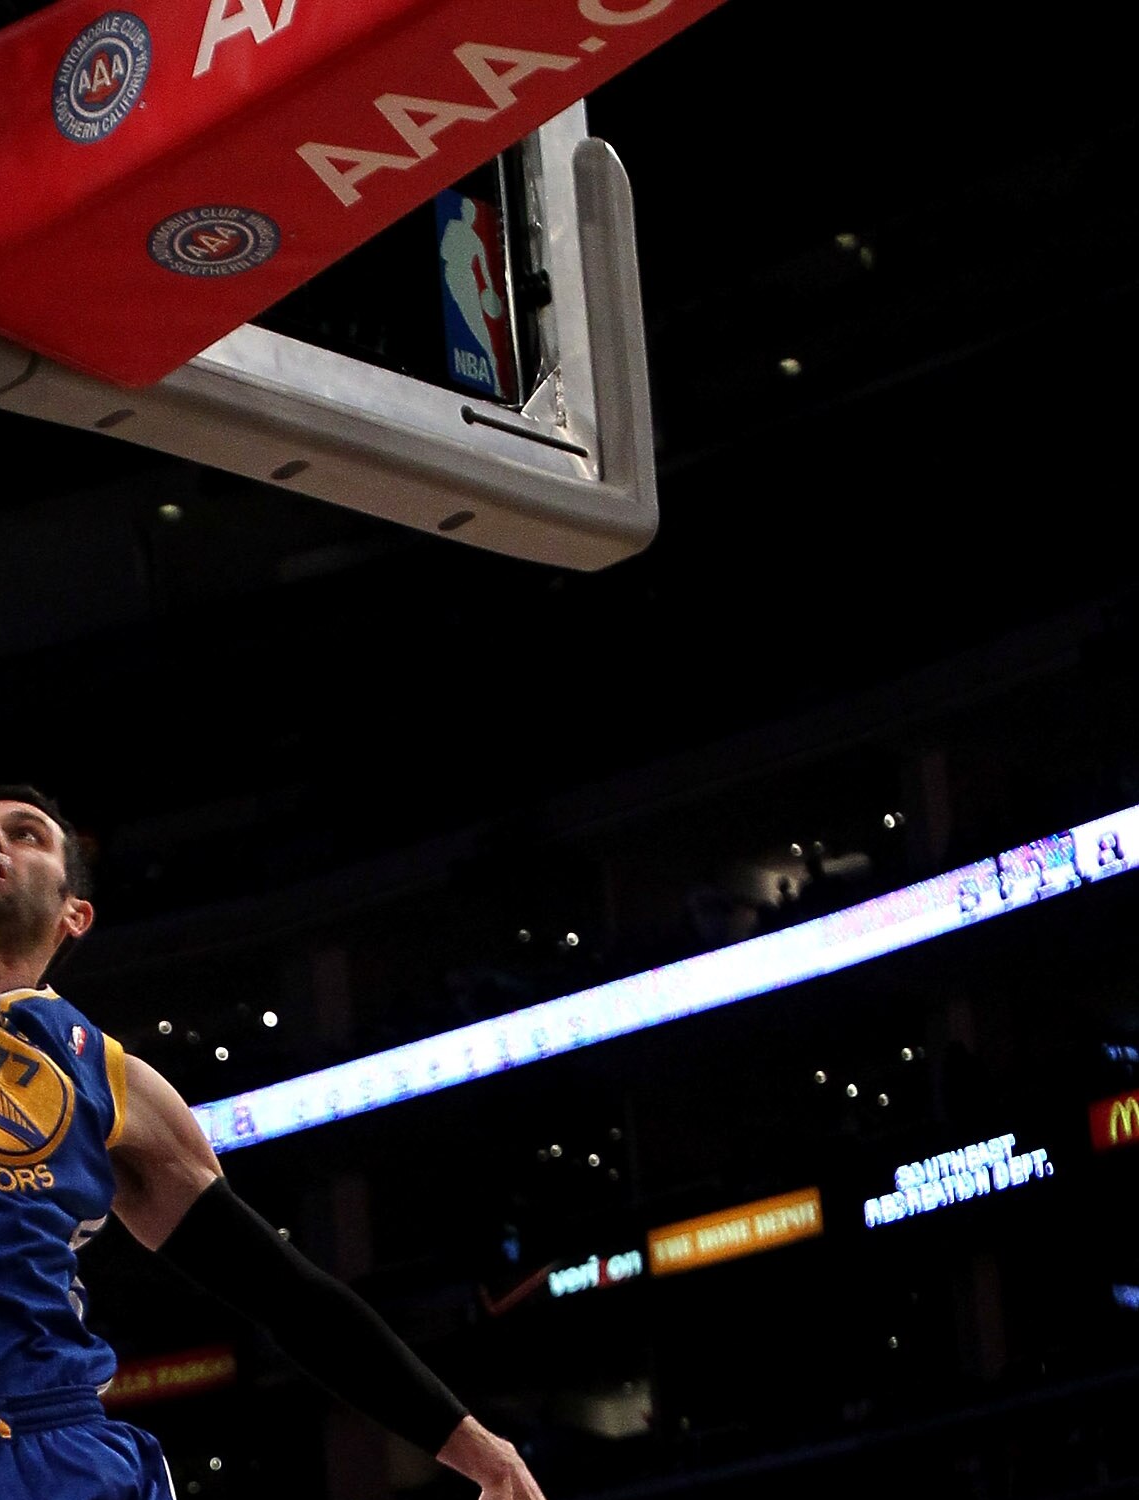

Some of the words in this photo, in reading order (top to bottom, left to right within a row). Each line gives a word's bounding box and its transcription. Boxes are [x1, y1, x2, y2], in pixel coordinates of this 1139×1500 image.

[58, 16, 121, 84] AUTOMOBILE
[120, 18, 147, 48] CLUB
[55, 92, 99, 139] SOUTHERN
[102, 49, 149, 132] CALIFORNIA
[77, 54, 125, 95] AAA
[186, 225, 238, 257] AAA
[453, 347, 491, 385] NBA
